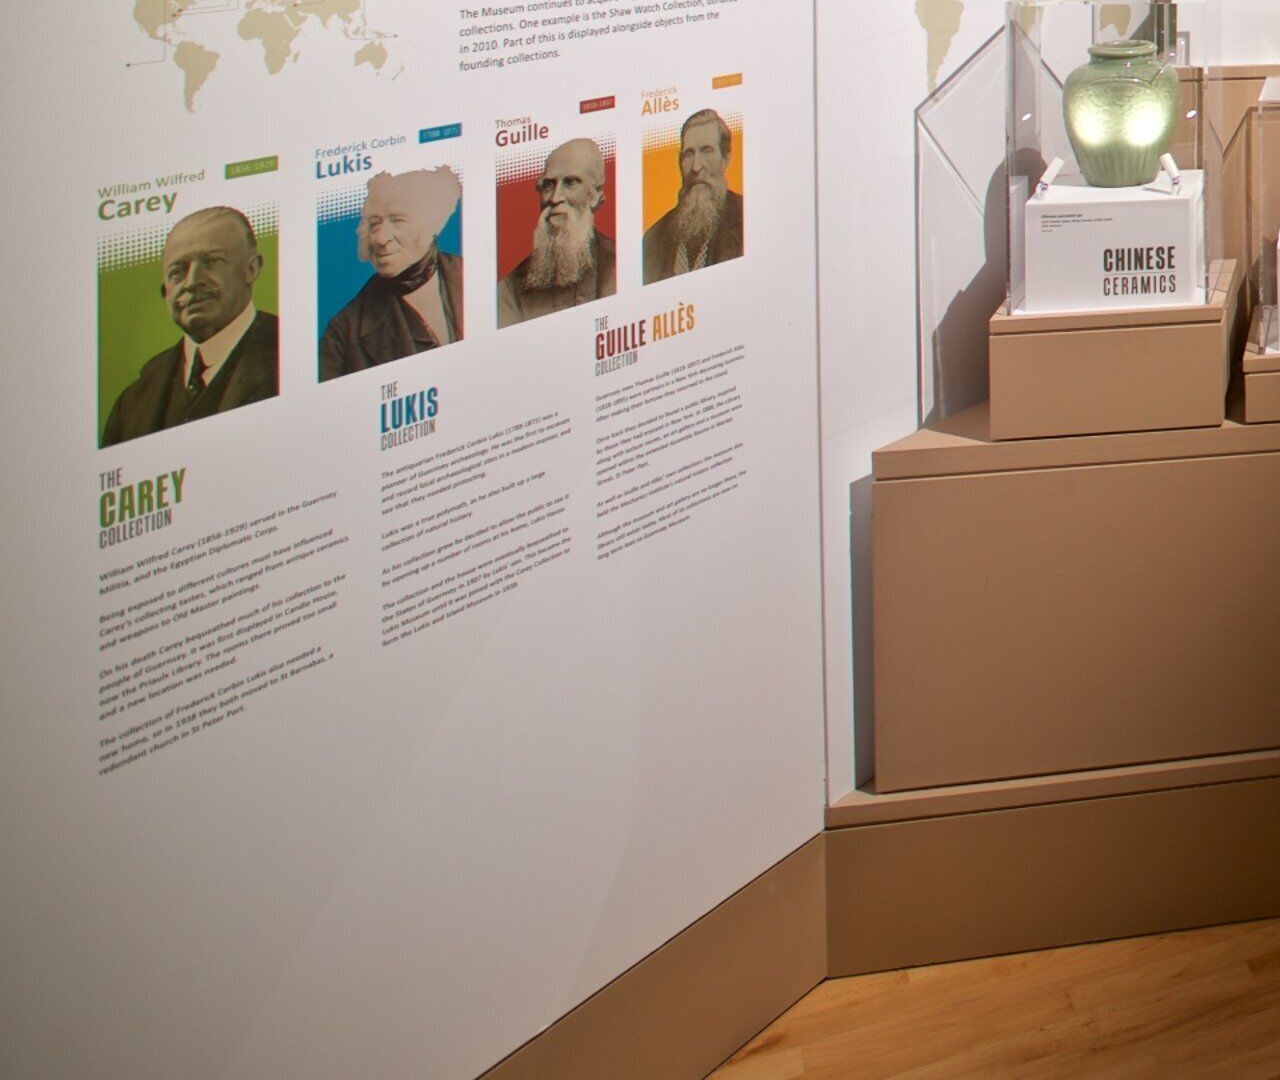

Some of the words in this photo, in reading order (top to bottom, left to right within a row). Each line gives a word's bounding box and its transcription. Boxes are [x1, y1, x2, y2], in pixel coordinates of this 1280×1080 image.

[641, 95, 680, 117] Allès
[495, 116, 531, 130] Thomas
[495, 123, 549, 147] Guille
[315, 140, 368, 159] Frederick
[371, 134, 406, 149] Corbin
[316, 153, 373, 179] Lukis
[97, 182, 151, 199] William
[155, 169, 205, 188] Wilfred
[97, 192, 178, 221] Carey
[1103, 246, 1176, 272] CHINESE
[1103, 274, 1176, 296] CERAMICS
[594, 314, 609, 331] THE
[595, 319, 647, 361] GUILLE
[652, 302, 695, 343] ALLÈS
[594, 349, 639, 377] COLLECTION
[380, 381, 399, 401] THE
[380, 386, 439, 434] LUKIS
[380, 418, 436, 452] COLLECTION
[99, 467, 123, 491] THE
[99, 468, 187, 529] CAREY
[99, 508, 173, 550] COLLECTION
